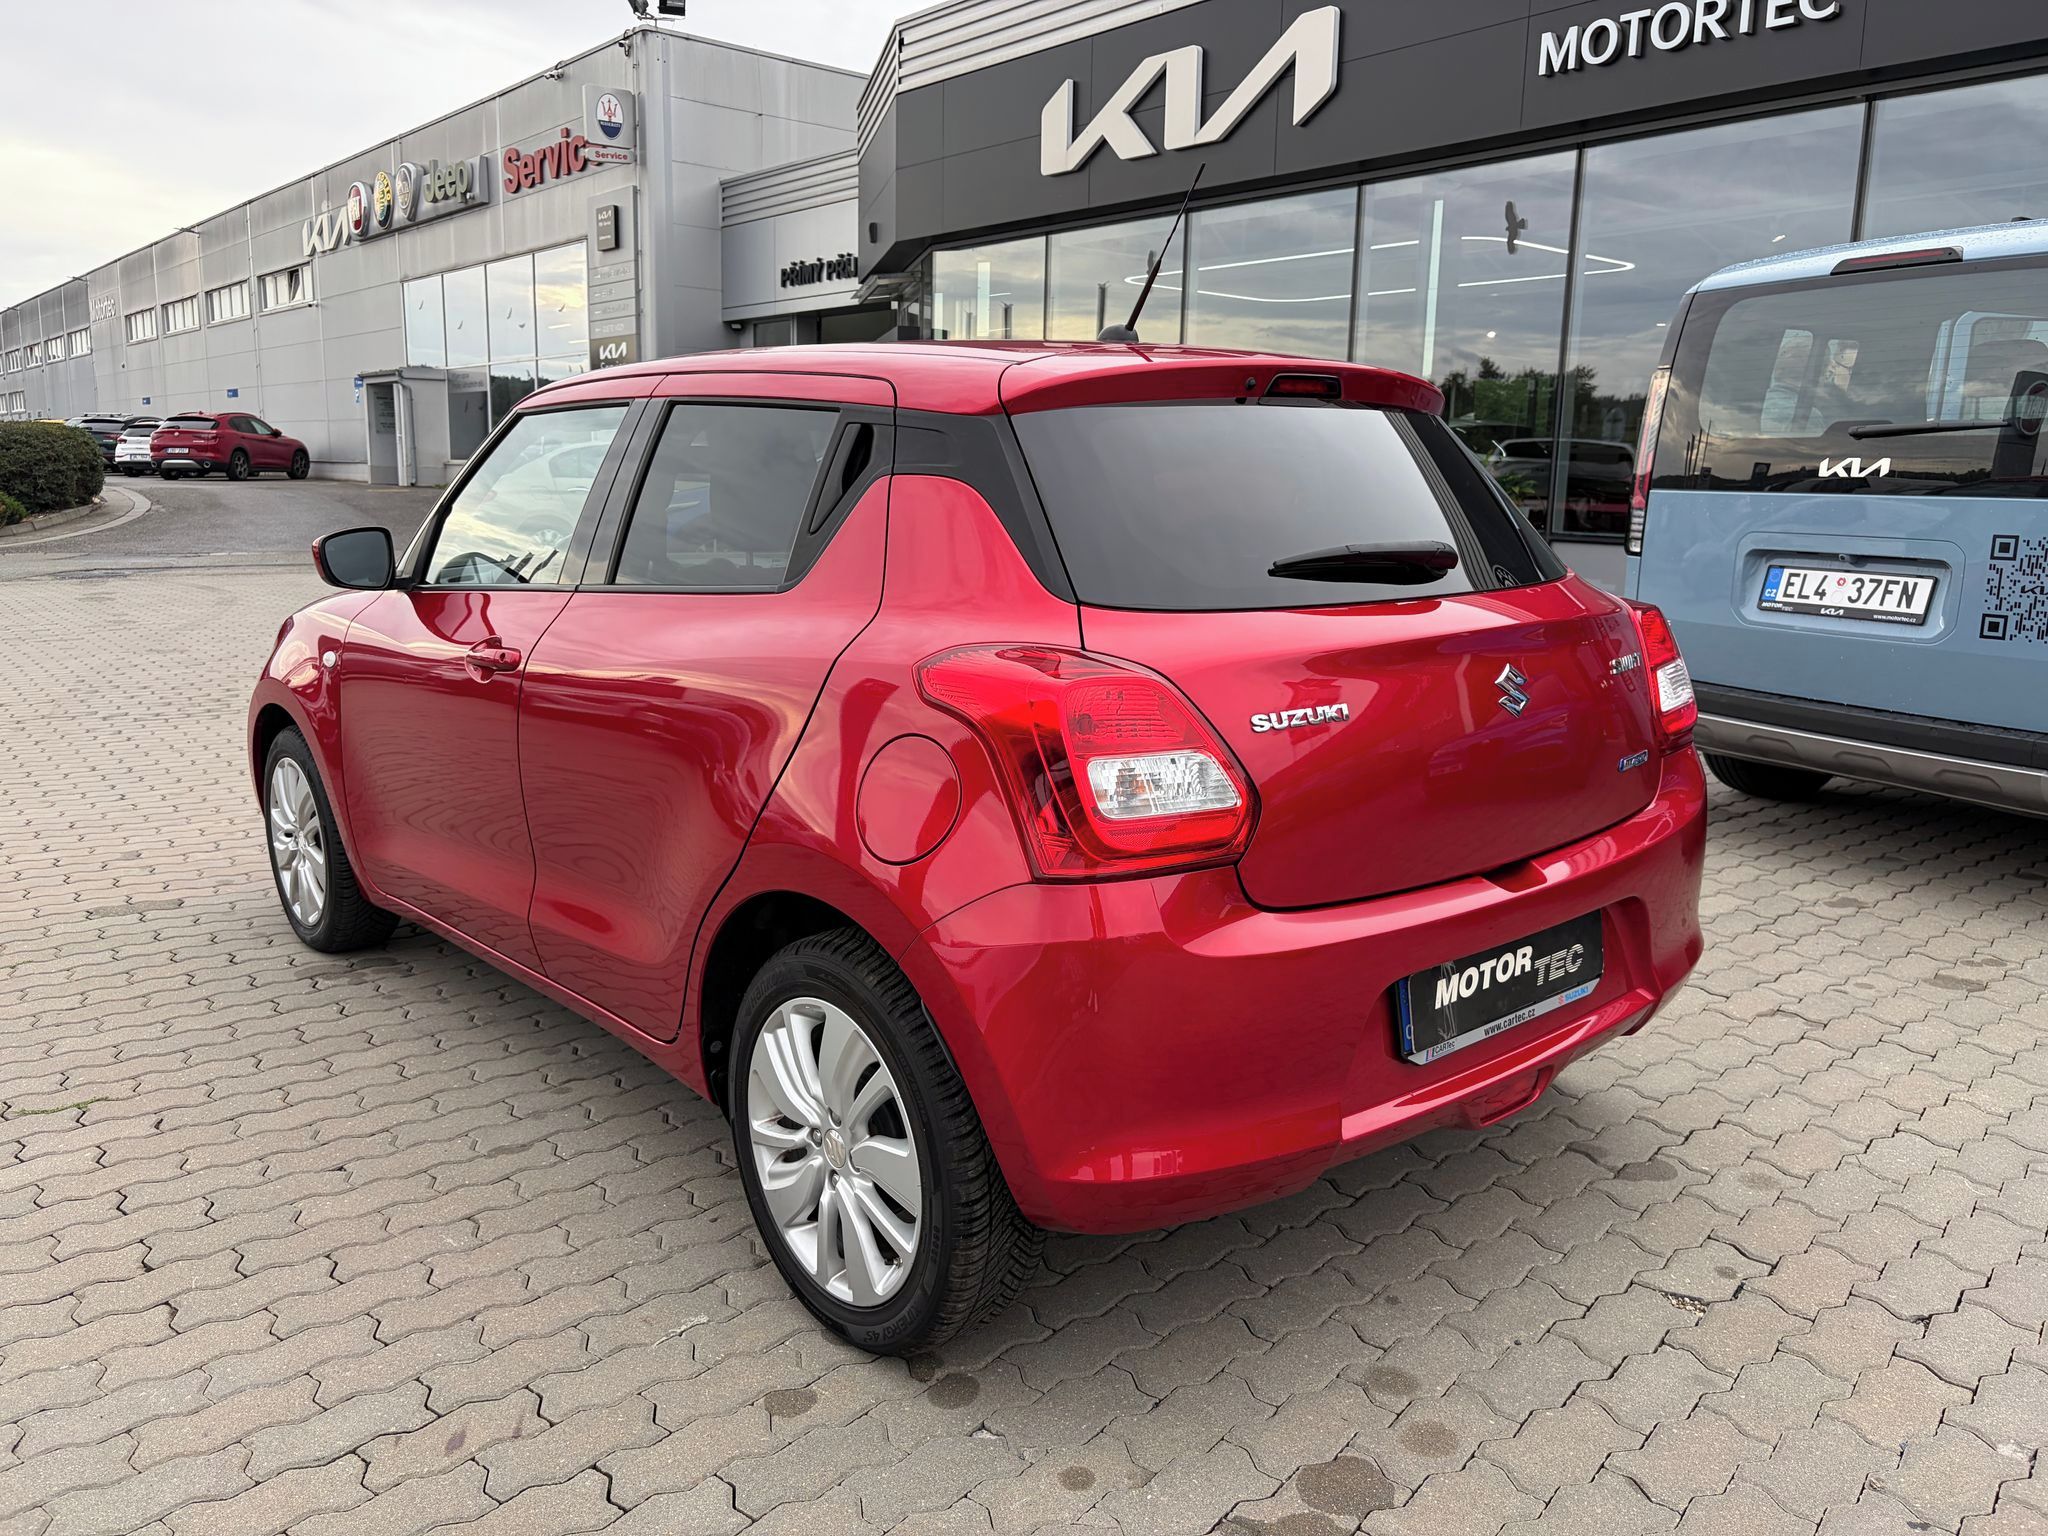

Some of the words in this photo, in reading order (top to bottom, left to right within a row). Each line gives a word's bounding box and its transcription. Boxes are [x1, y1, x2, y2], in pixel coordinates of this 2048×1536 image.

[1040, 5, 1341, 176] KIA
[503, 127, 603, 193] Servic
[595, 150, 628, 160] Service
[423, 159, 469, 204] Jeep
[302, 206, 350, 257] KIA
[599, 342, 627, 360] KIA
[1818, 457, 1891, 478] KIA
[1764, 588, 1777, 597] CZ
[1782, 572, 1828, 601] EL4
[1847, 577, 1919, 609] 37FN
[2021, 585, 2048, 595] KI
[1820, 607, 1844, 616] KIA
[1251, 703, 1350, 733] SUZUKI
[1434, 945, 1533, 1010] MOTOR
[1533, 943, 1584, 986] TEC
[1564, 986, 1589, 1002] SUZUKI
[1483, 1008, 1536, 1037] www.cartec.cz
